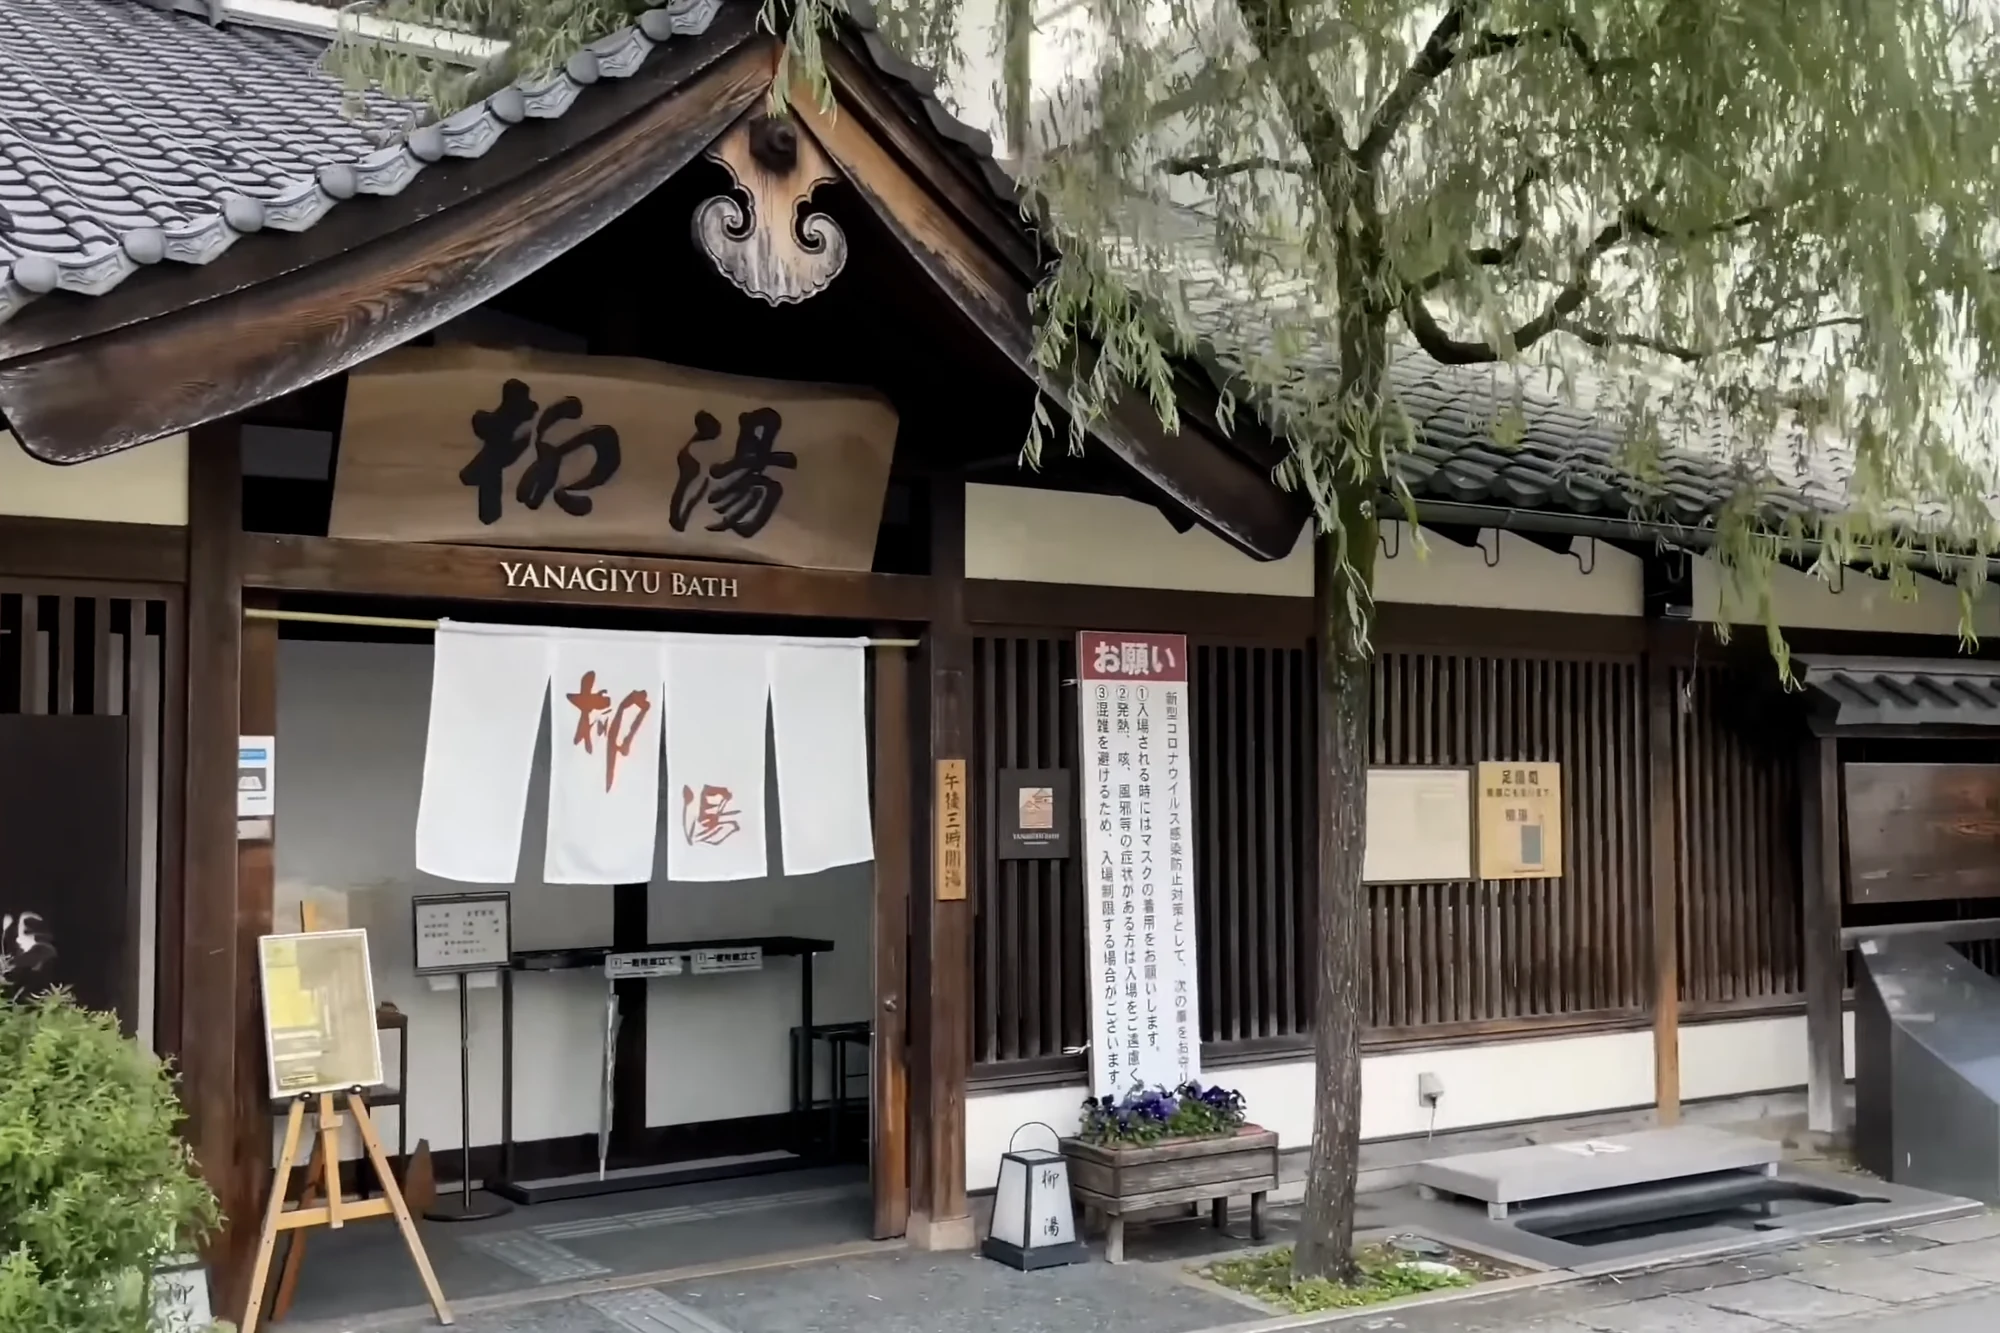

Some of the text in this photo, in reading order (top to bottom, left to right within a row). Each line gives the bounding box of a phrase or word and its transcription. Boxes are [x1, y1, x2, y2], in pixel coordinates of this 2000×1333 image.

[460, 378, 796, 538] 柳湯
[500, 561, 738, 597] YANAGIYU BATH
[1093, 641, 1176, 676] お願い
